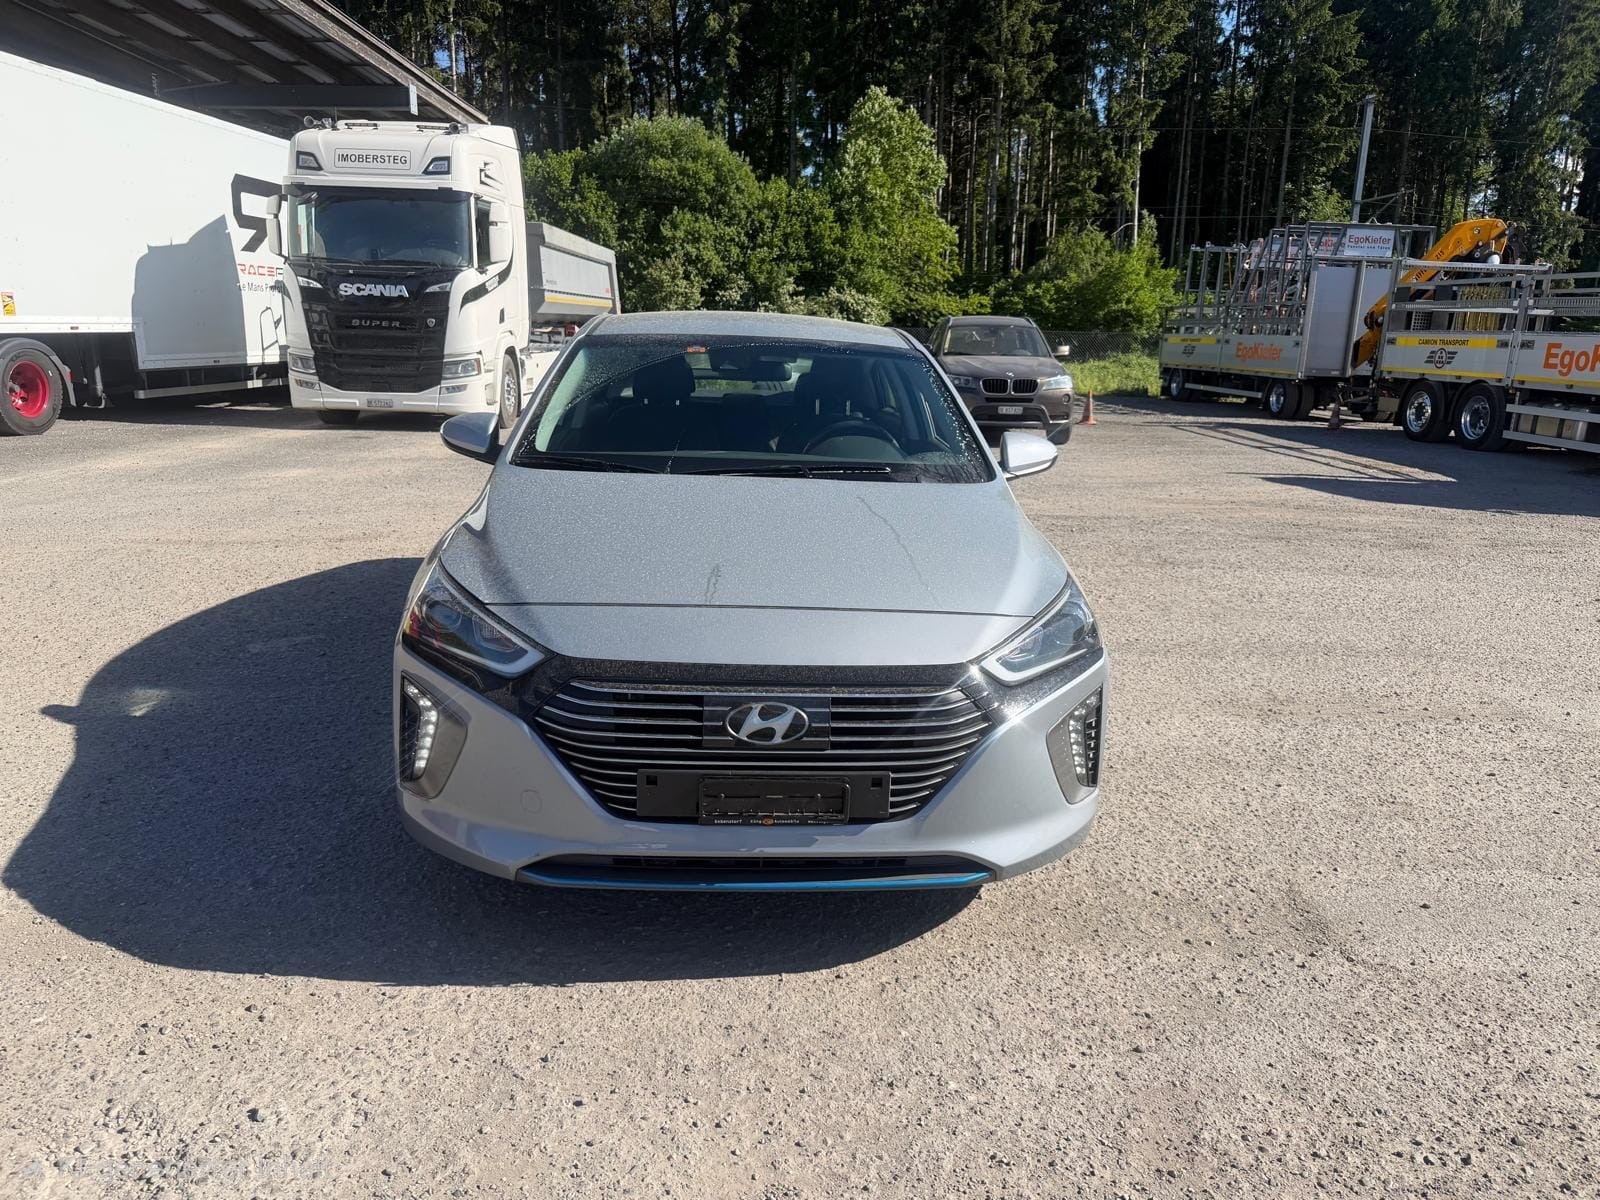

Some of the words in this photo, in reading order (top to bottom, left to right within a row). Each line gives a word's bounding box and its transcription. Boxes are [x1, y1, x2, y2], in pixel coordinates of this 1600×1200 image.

[337, 153, 408, 165] IMOBERSTEG
[1348, 234, 1392, 245] EgoKiefer
[339, 282, 409, 298] SCANIA
[351, 319, 401, 328] SUPER
